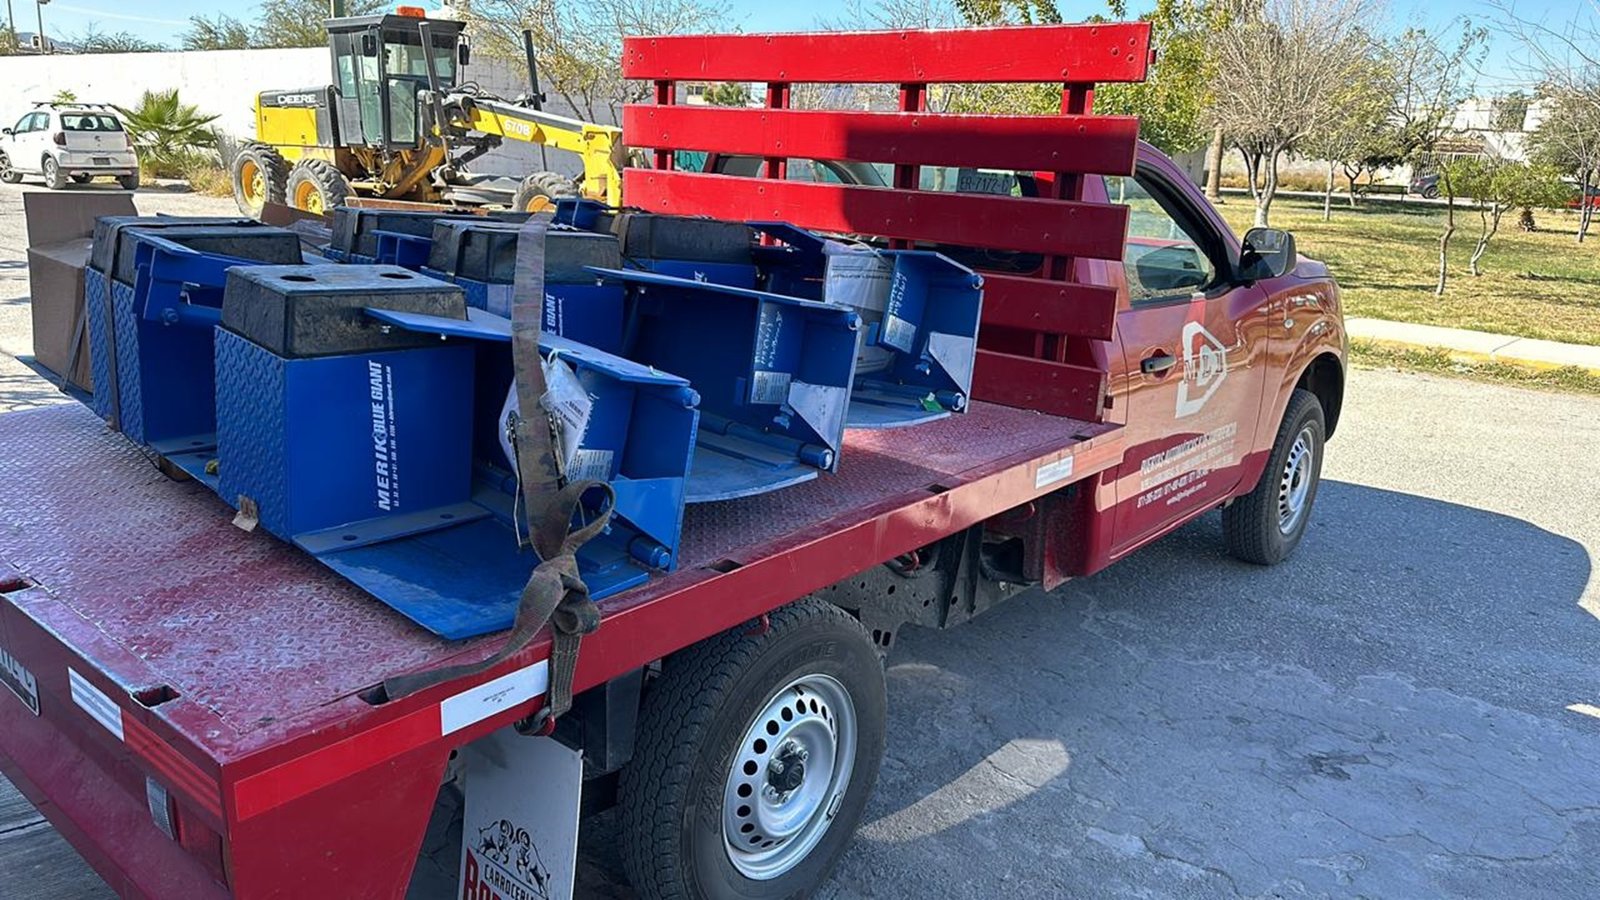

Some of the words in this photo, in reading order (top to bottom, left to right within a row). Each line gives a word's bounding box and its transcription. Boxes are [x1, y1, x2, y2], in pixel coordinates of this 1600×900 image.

[277, 94, 317, 105] DEERE
[545, 292, 556, 327] GIANT
[368, 359, 383, 401] GIANT
[372, 402, 386, 432] BLUE
[374, 436, 391, 511] MERIK
